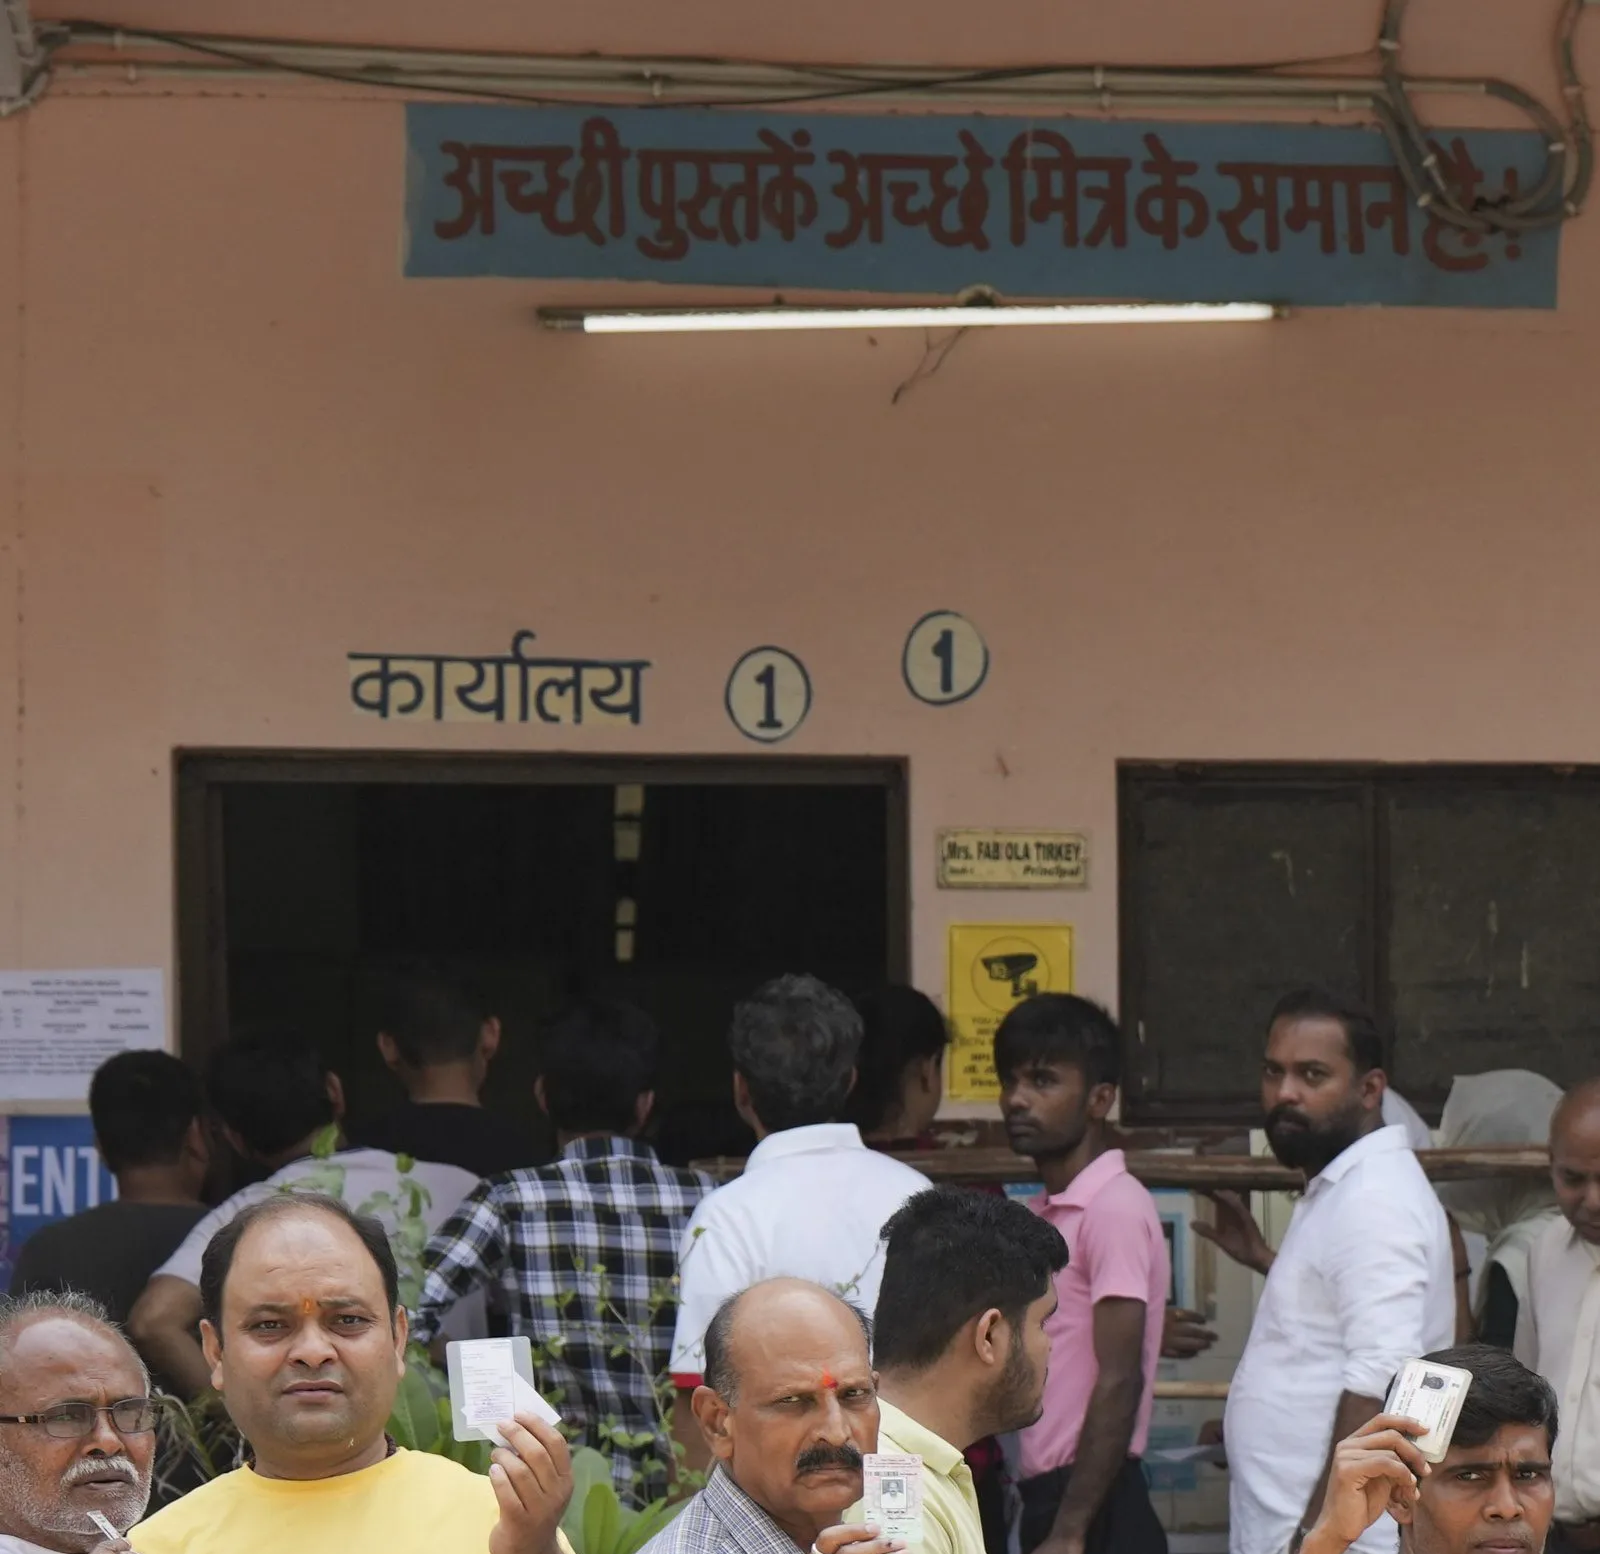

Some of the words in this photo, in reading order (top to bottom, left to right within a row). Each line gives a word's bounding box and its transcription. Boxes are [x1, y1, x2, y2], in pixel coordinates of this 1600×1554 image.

[434, 116, 631, 246] अच्छी
[636, 127, 818, 261] पुस्तकें
[824, 128, 994, 251] अच्छे
[1002, 129, 1133, 249] मित्र
[1135, 132, 1209, 250] के
[1216, 161, 1413, 256] समान
[347, 629, 652, 726] कार्यालय
[931, 629, 954, 695] 1
[754, 664, 783, 731] 1
[977, 842, 1031, 862] FABOLA
